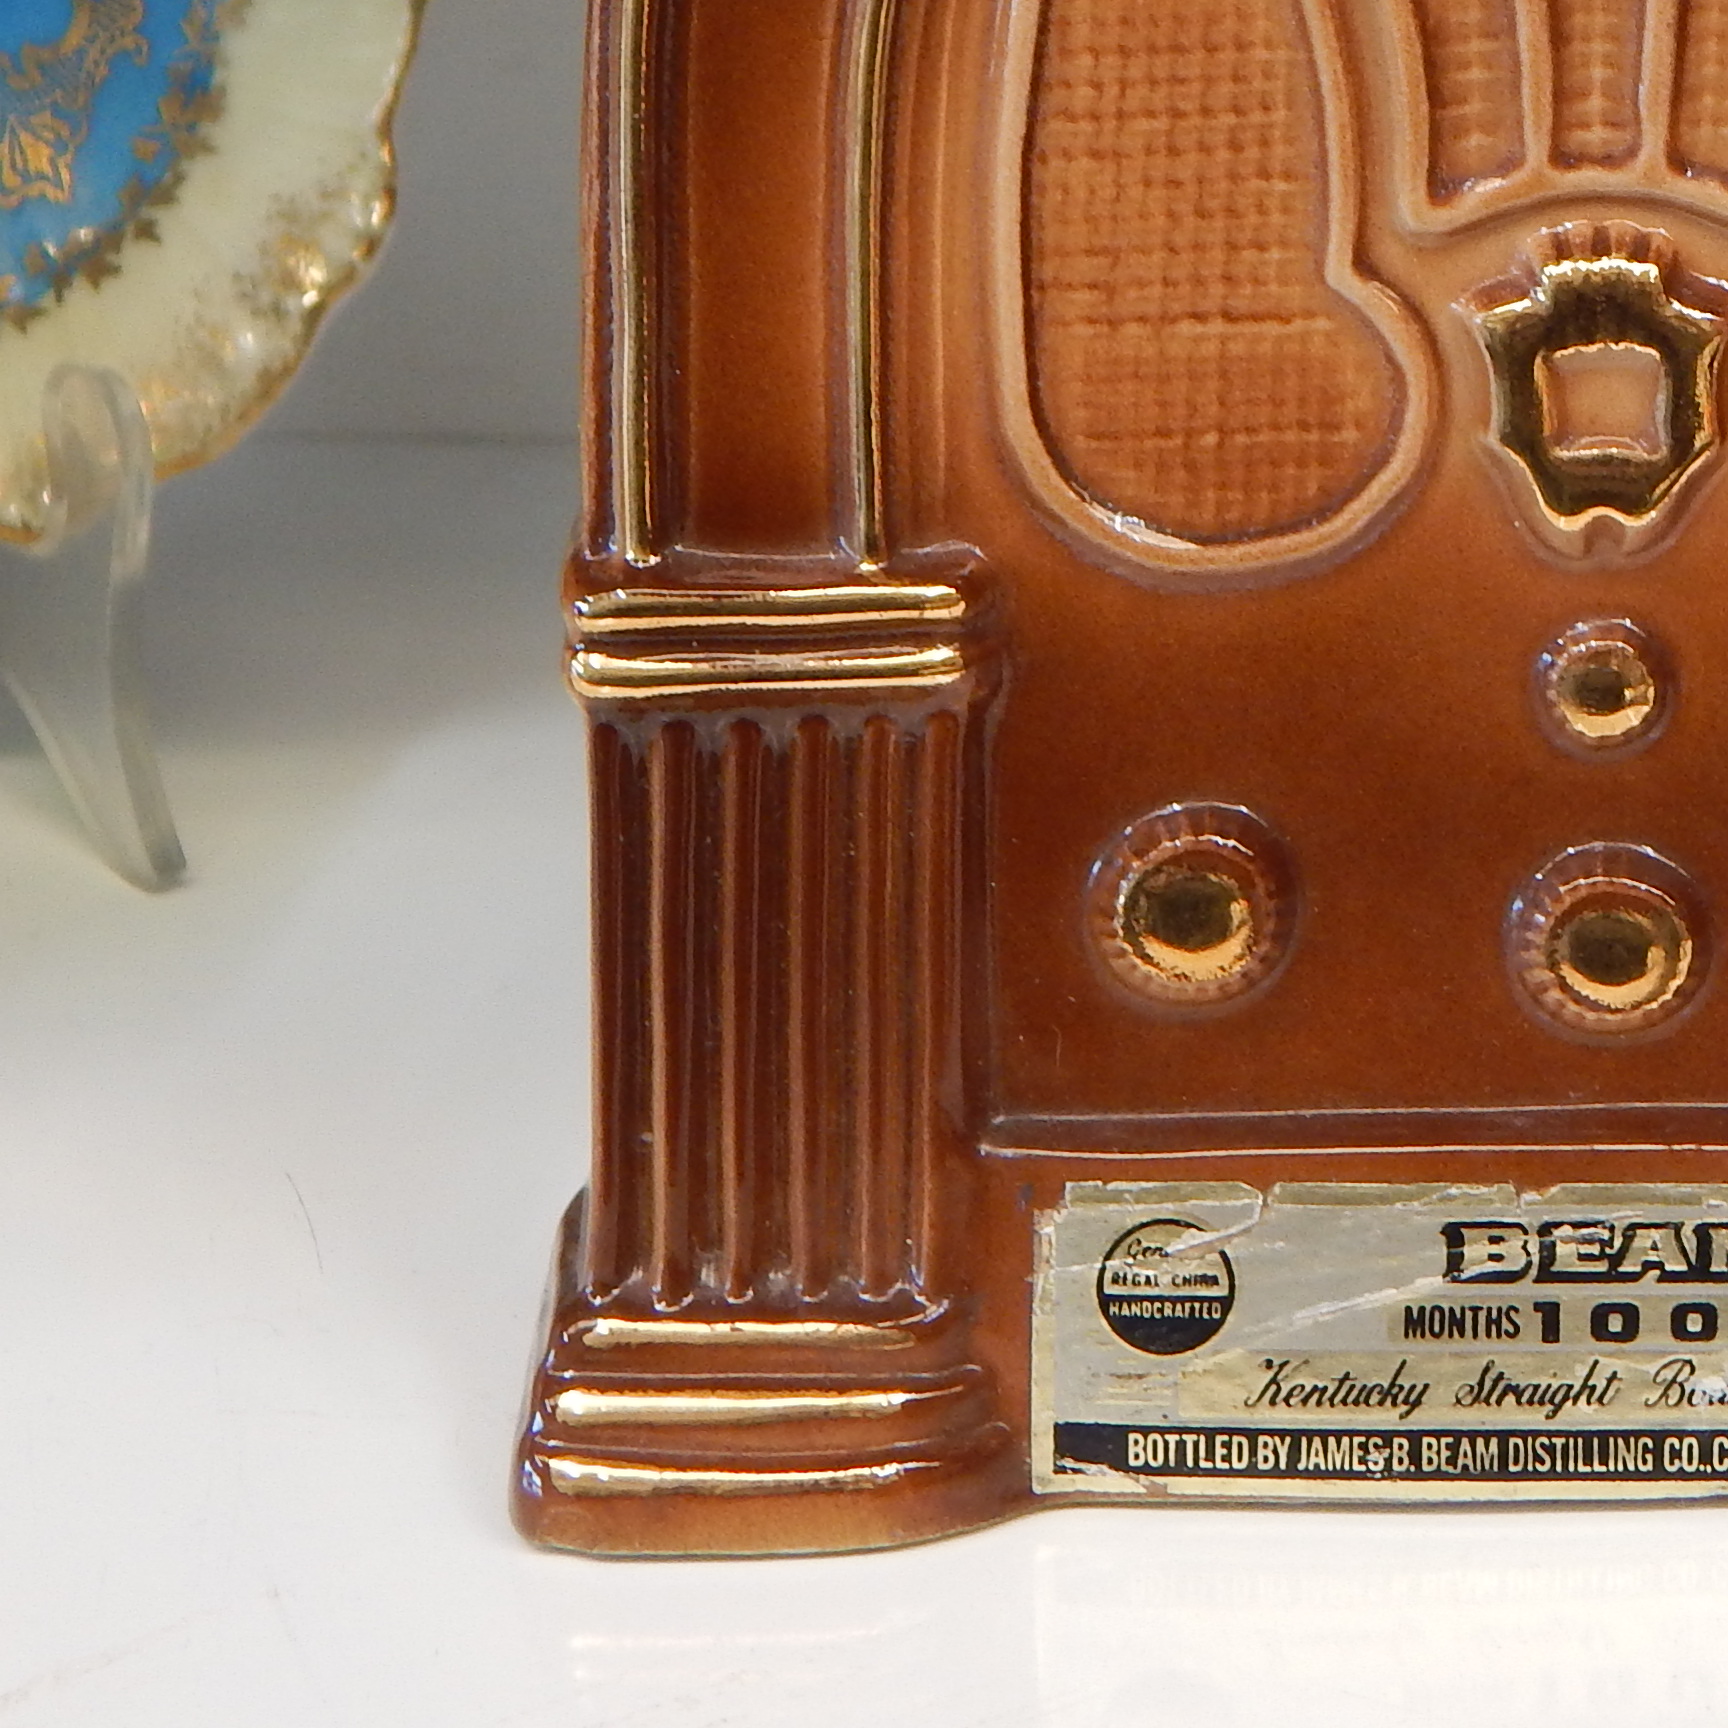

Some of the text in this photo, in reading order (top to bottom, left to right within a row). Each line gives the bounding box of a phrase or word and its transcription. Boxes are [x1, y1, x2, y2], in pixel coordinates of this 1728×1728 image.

[1110, 1271, 1161, 1288] REGAL
[1108, 1301, 1222, 1320] HANDCRAFTED
[1402, 1304, 1522, 1340] MONTHS
[1532, 1300, 1719, 1344] 100
[1244, 1358, 1431, 1421] Kentucky
[1453, 1358, 1622, 1421] Straight
[1127, 1431, 1250, 1470] BOTTLED
[1256, 1434, 1292, 1471] BY
[1296, 1435, 1386, 1472] JAMES
[1391, 1436, 1416, 1473] B.
[1421, 1436, 1499, 1474] BEAM
[1508, 1436, 1654, 1473] DISTILLING
